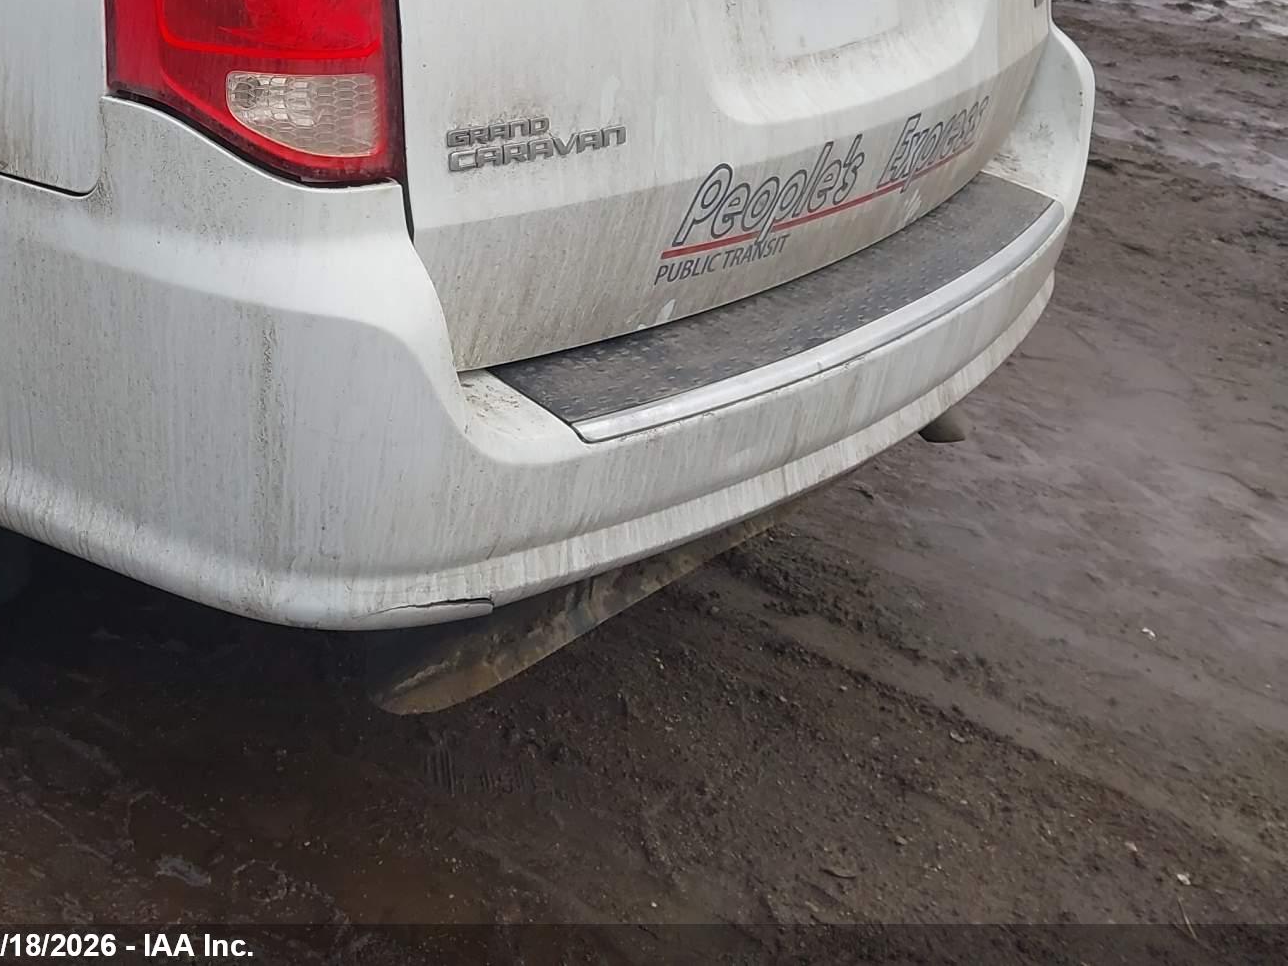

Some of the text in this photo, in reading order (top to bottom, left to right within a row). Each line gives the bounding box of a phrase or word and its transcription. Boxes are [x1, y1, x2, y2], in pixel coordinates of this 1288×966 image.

[447, 116, 550, 148] GRAND
[448, 125, 627, 172] CARAVAN
[672, 95, 990, 246] People's Express
[655, 234, 791, 285] PUBLIC TRANSIT
